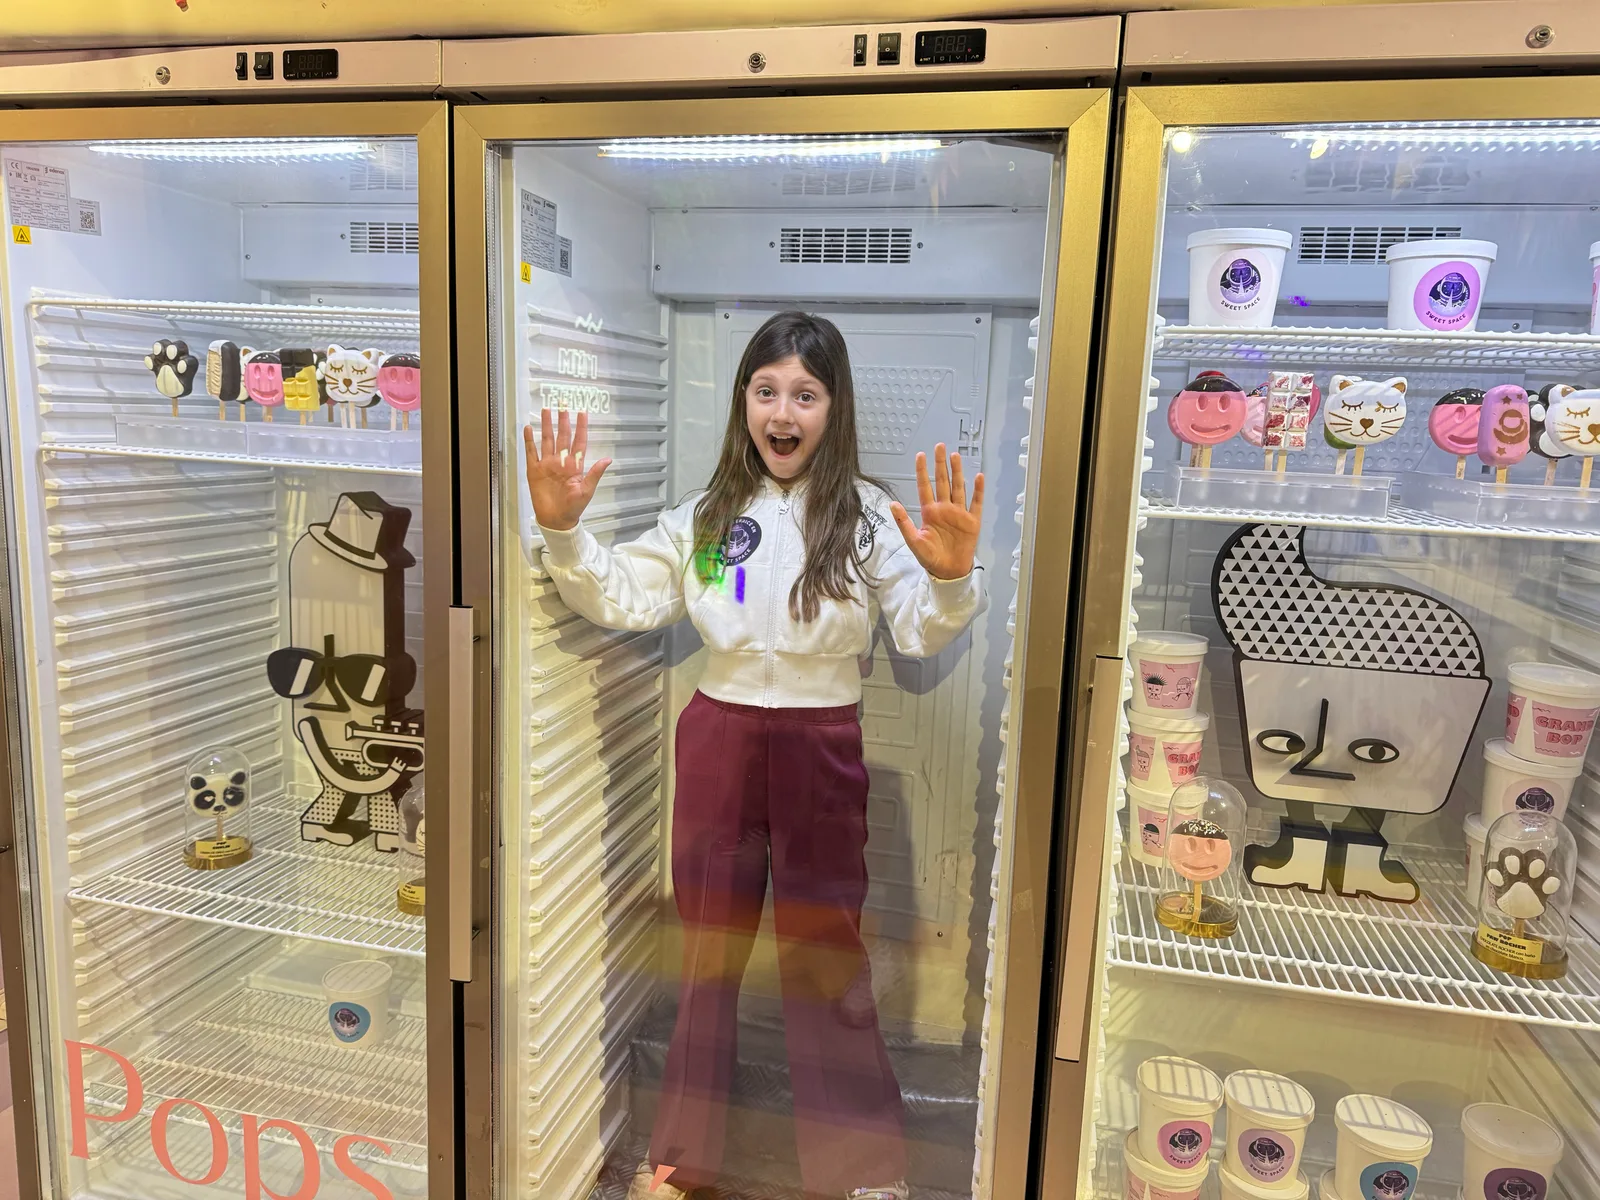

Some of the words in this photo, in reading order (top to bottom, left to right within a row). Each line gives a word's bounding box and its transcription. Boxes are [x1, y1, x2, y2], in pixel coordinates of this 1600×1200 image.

[1220, 300, 1241, 311] SWEET
[1243, 296, 1261, 310] SPACE
[1425, 310, 1446, 324] SWEET
[1448, 313, 1466, 325] SPACE
[735, 548, 752, 563] SPACE
[1546, 731, 1583, 745] BOP
[1486, 933, 1499, 942] PAW
[1499, 939, 1527, 950] ROCHER
[1498, 933, 1512, 941] POP
[64, 1039, 394, 1200] Pops
[1169, 1154, 1187, 1164] SWEET
[1188, 1152, 1201, 1164] SPACE
[1250, 1163, 1268, 1176] SWEET
[1269, 1165, 1285, 1177] SPACE
